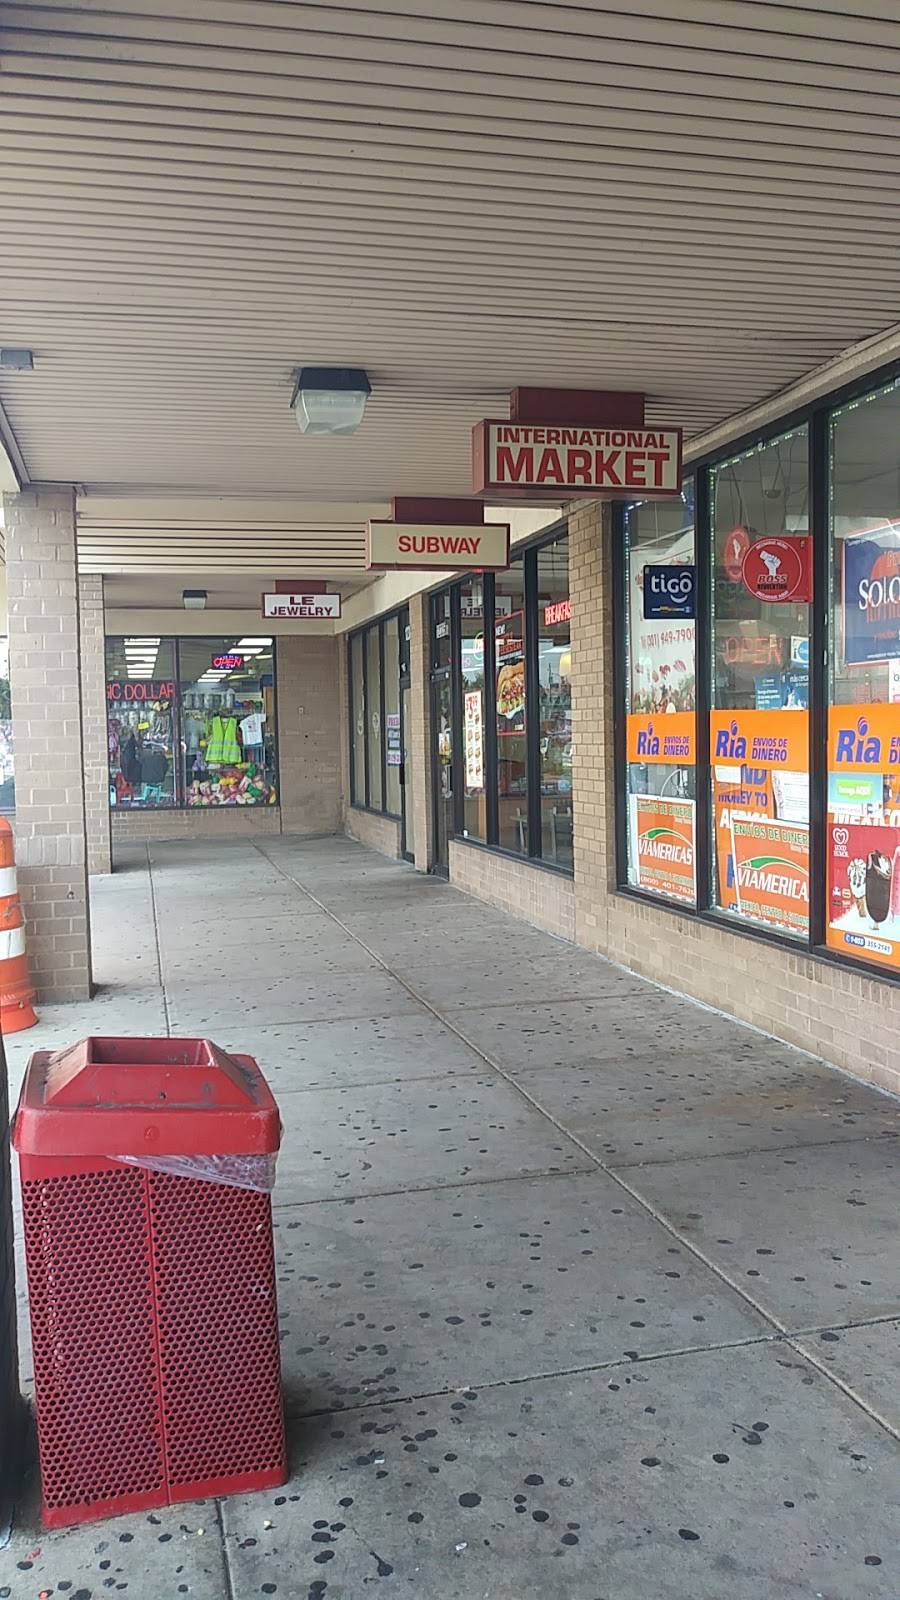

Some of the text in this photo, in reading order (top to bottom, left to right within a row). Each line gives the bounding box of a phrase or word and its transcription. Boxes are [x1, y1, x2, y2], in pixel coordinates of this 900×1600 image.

[497, 427, 670, 449] INTERNATIONAL
[496, 446, 670, 487] MARKET
[398, 535, 481, 555] SUBWAY
[651, 571, 693, 594] tigo
[757, 574, 788, 584] BOSS
[289, 596, 315, 606] LE
[270, 606, 333, 616] JEWELRY
[213, 657, 241, 668] OPEN
[124, 682, 175, 700] DOLLAR
[637, 731, 659, 755] Ria
[664, 736, 690, 744] ENVIOS DE
[715, 729, 747, 759] Ria
[752, 737, 788, 748] ENVIOS DE
[836, 729, 881, 763] Ria
[663, 745, 690, 756] DINERO
[752, 748, 788, 762] DINERO
[754, 792, 768, 807] TO
[767, 828, 780, 839] DE
[638, 839, 692, 865] VIAMERICAS
[737, 867, 809, 902] VIAMERICA
